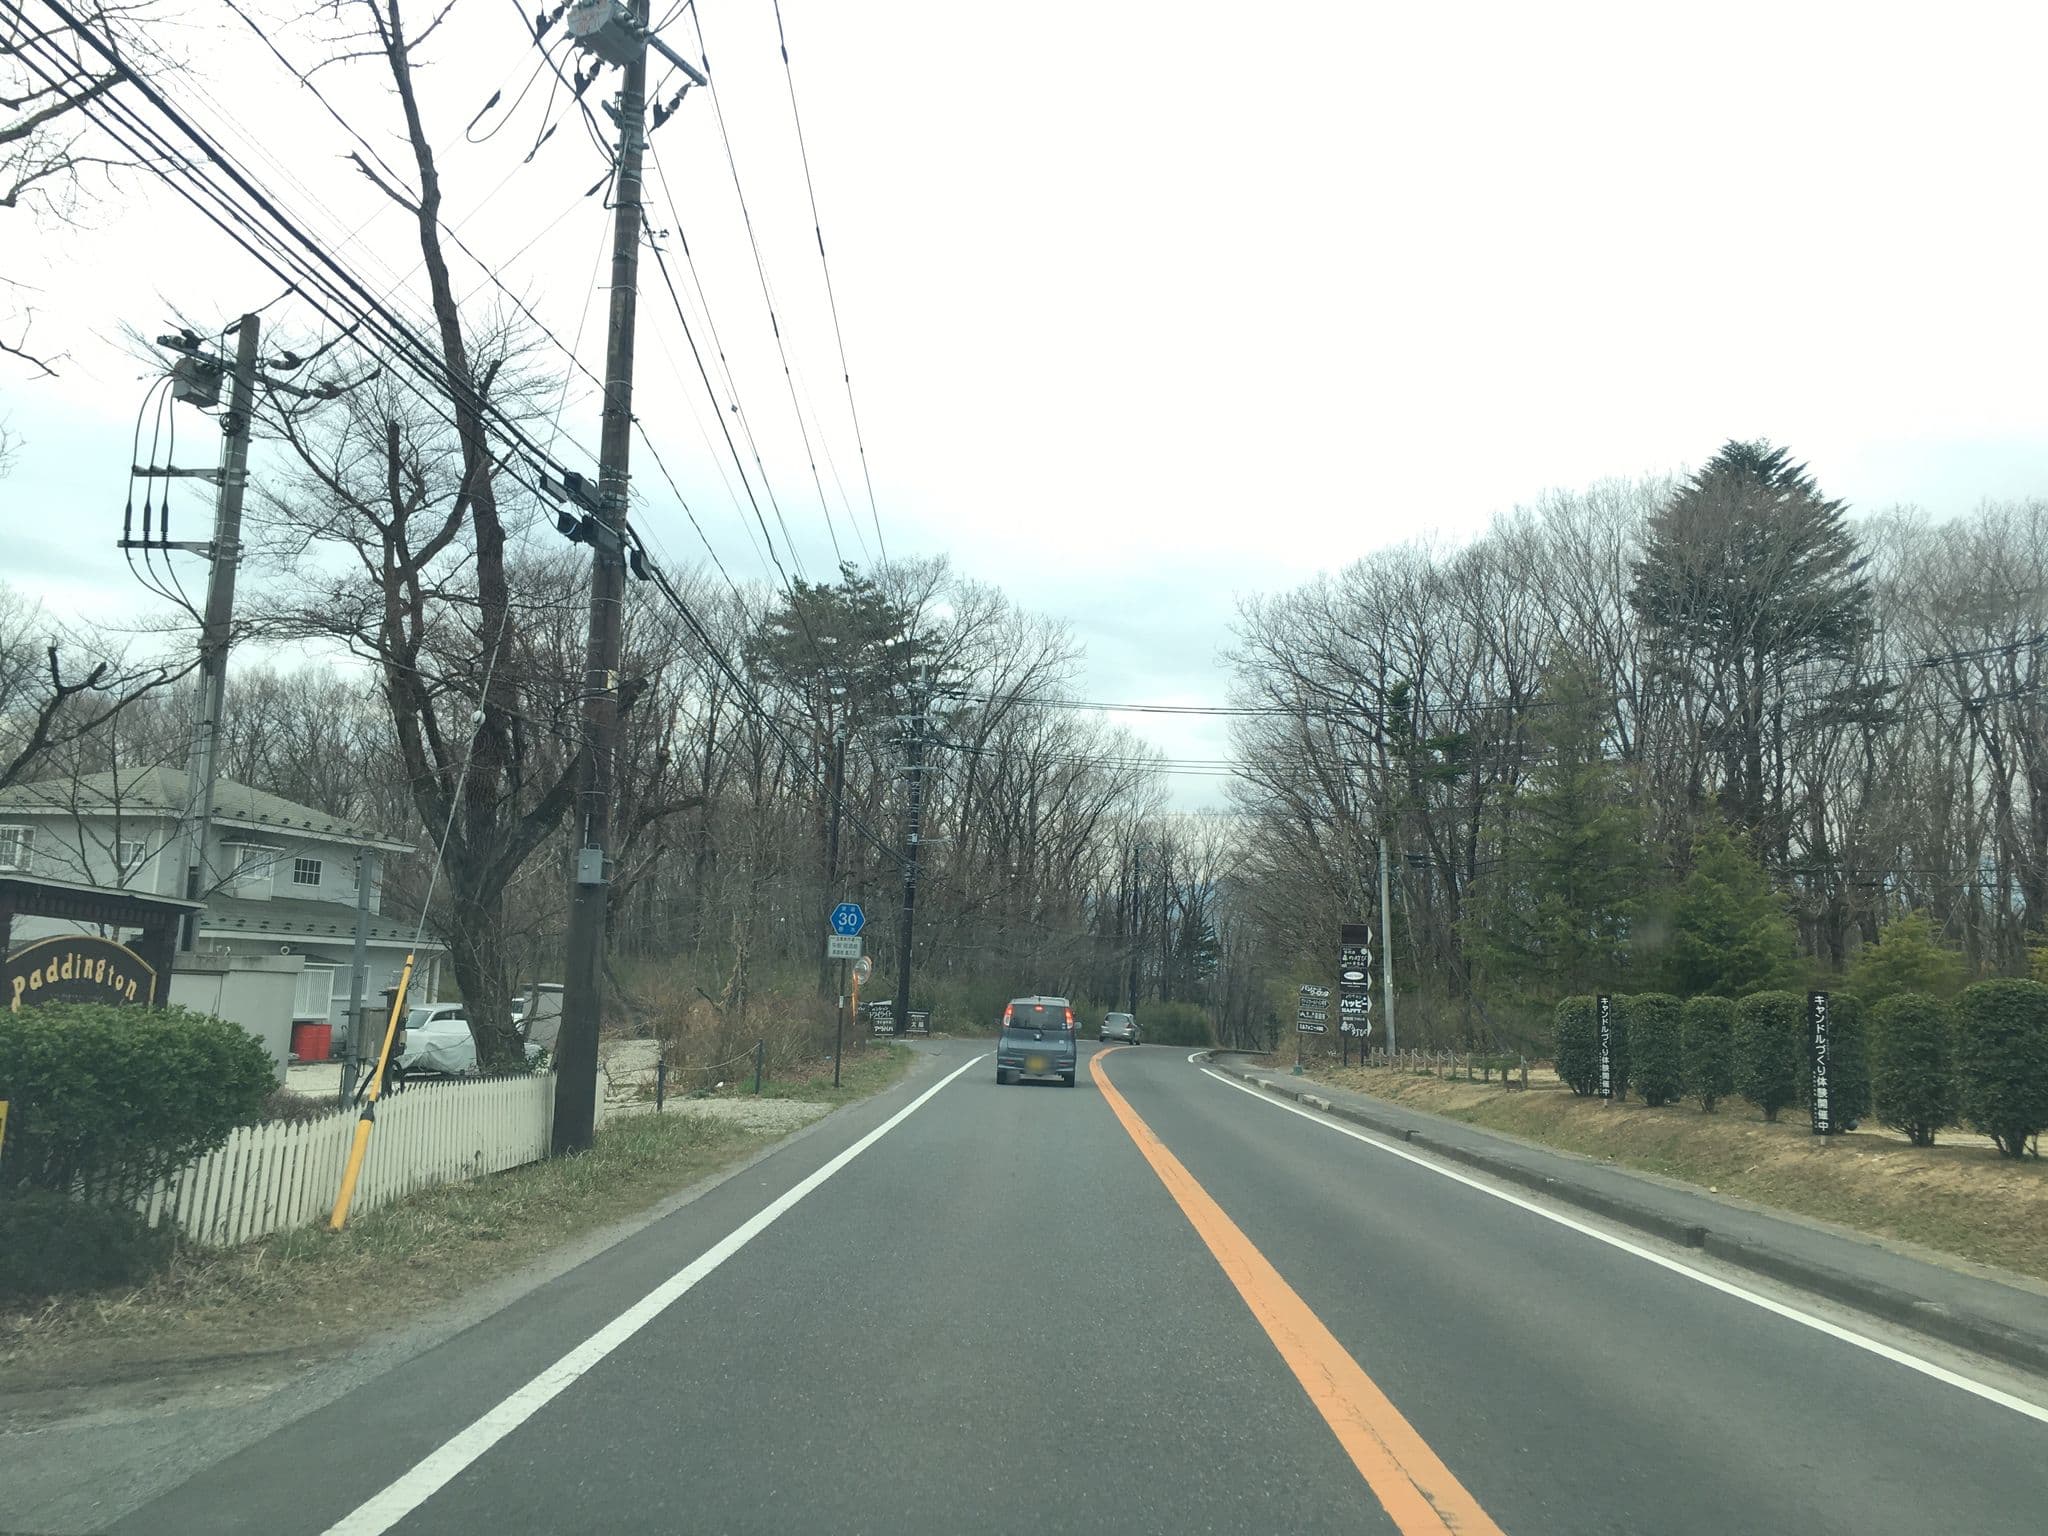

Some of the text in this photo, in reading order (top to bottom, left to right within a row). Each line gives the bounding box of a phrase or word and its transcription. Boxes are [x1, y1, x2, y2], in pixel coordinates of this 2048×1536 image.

[838, 912, 857, 926] 30
[1340, 997, 1368, 1007] ハッピー
